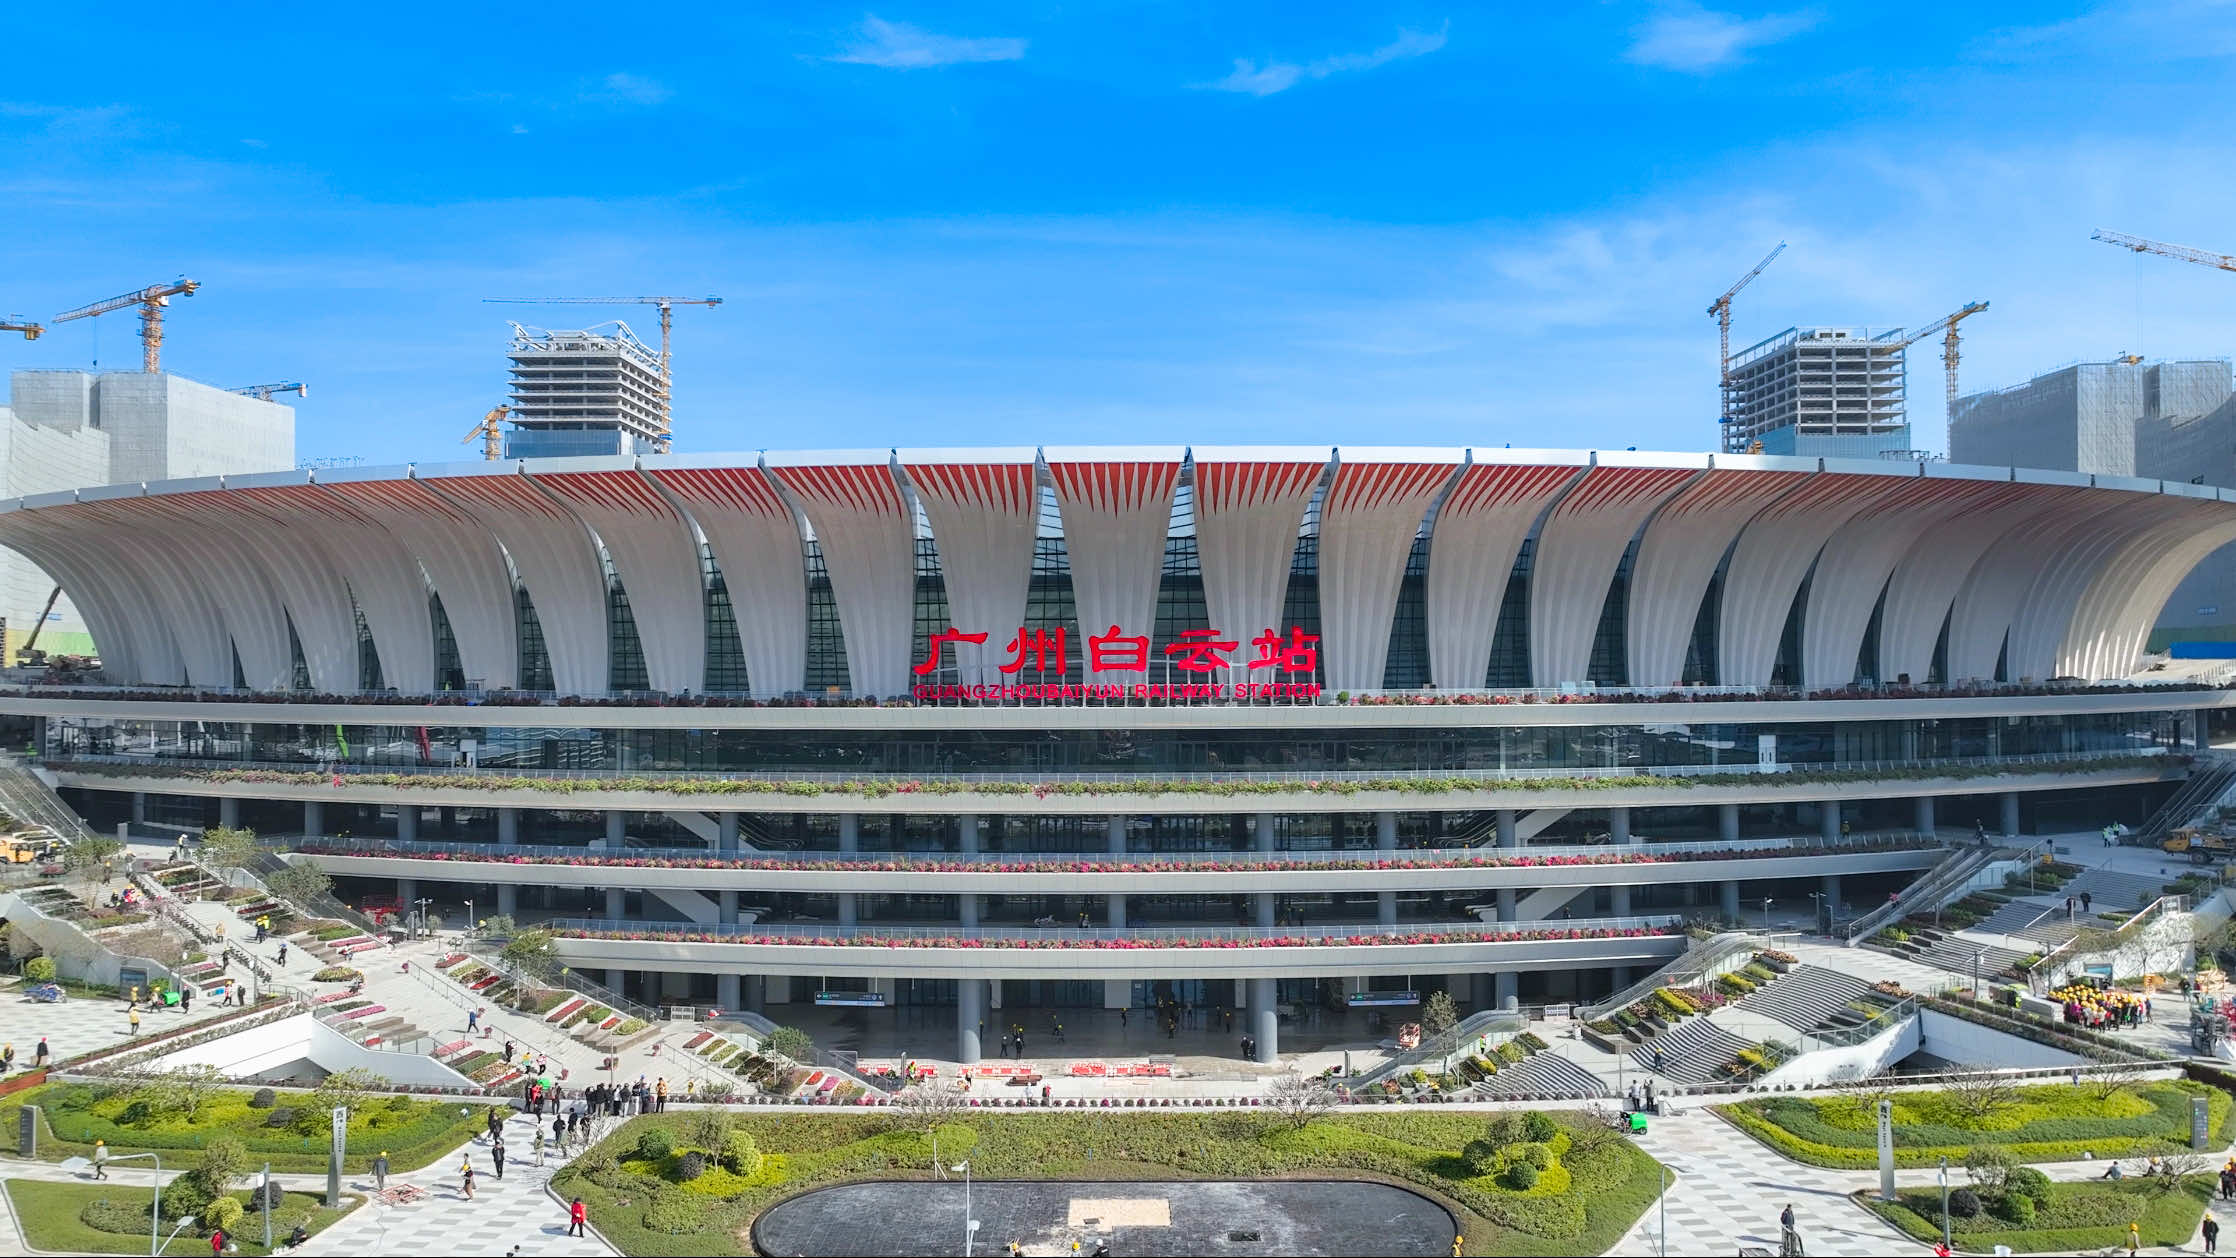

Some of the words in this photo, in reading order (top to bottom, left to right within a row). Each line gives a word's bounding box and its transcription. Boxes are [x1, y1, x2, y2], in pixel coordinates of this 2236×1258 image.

[913, 624, 1320, 676] 广州白云站
[913, 683, 1125, 699] GUANGZHOUBAIYUN
[1134, 683, 1224, 698] RAILWAY
[1234, 683, 1321, 698] STATION
